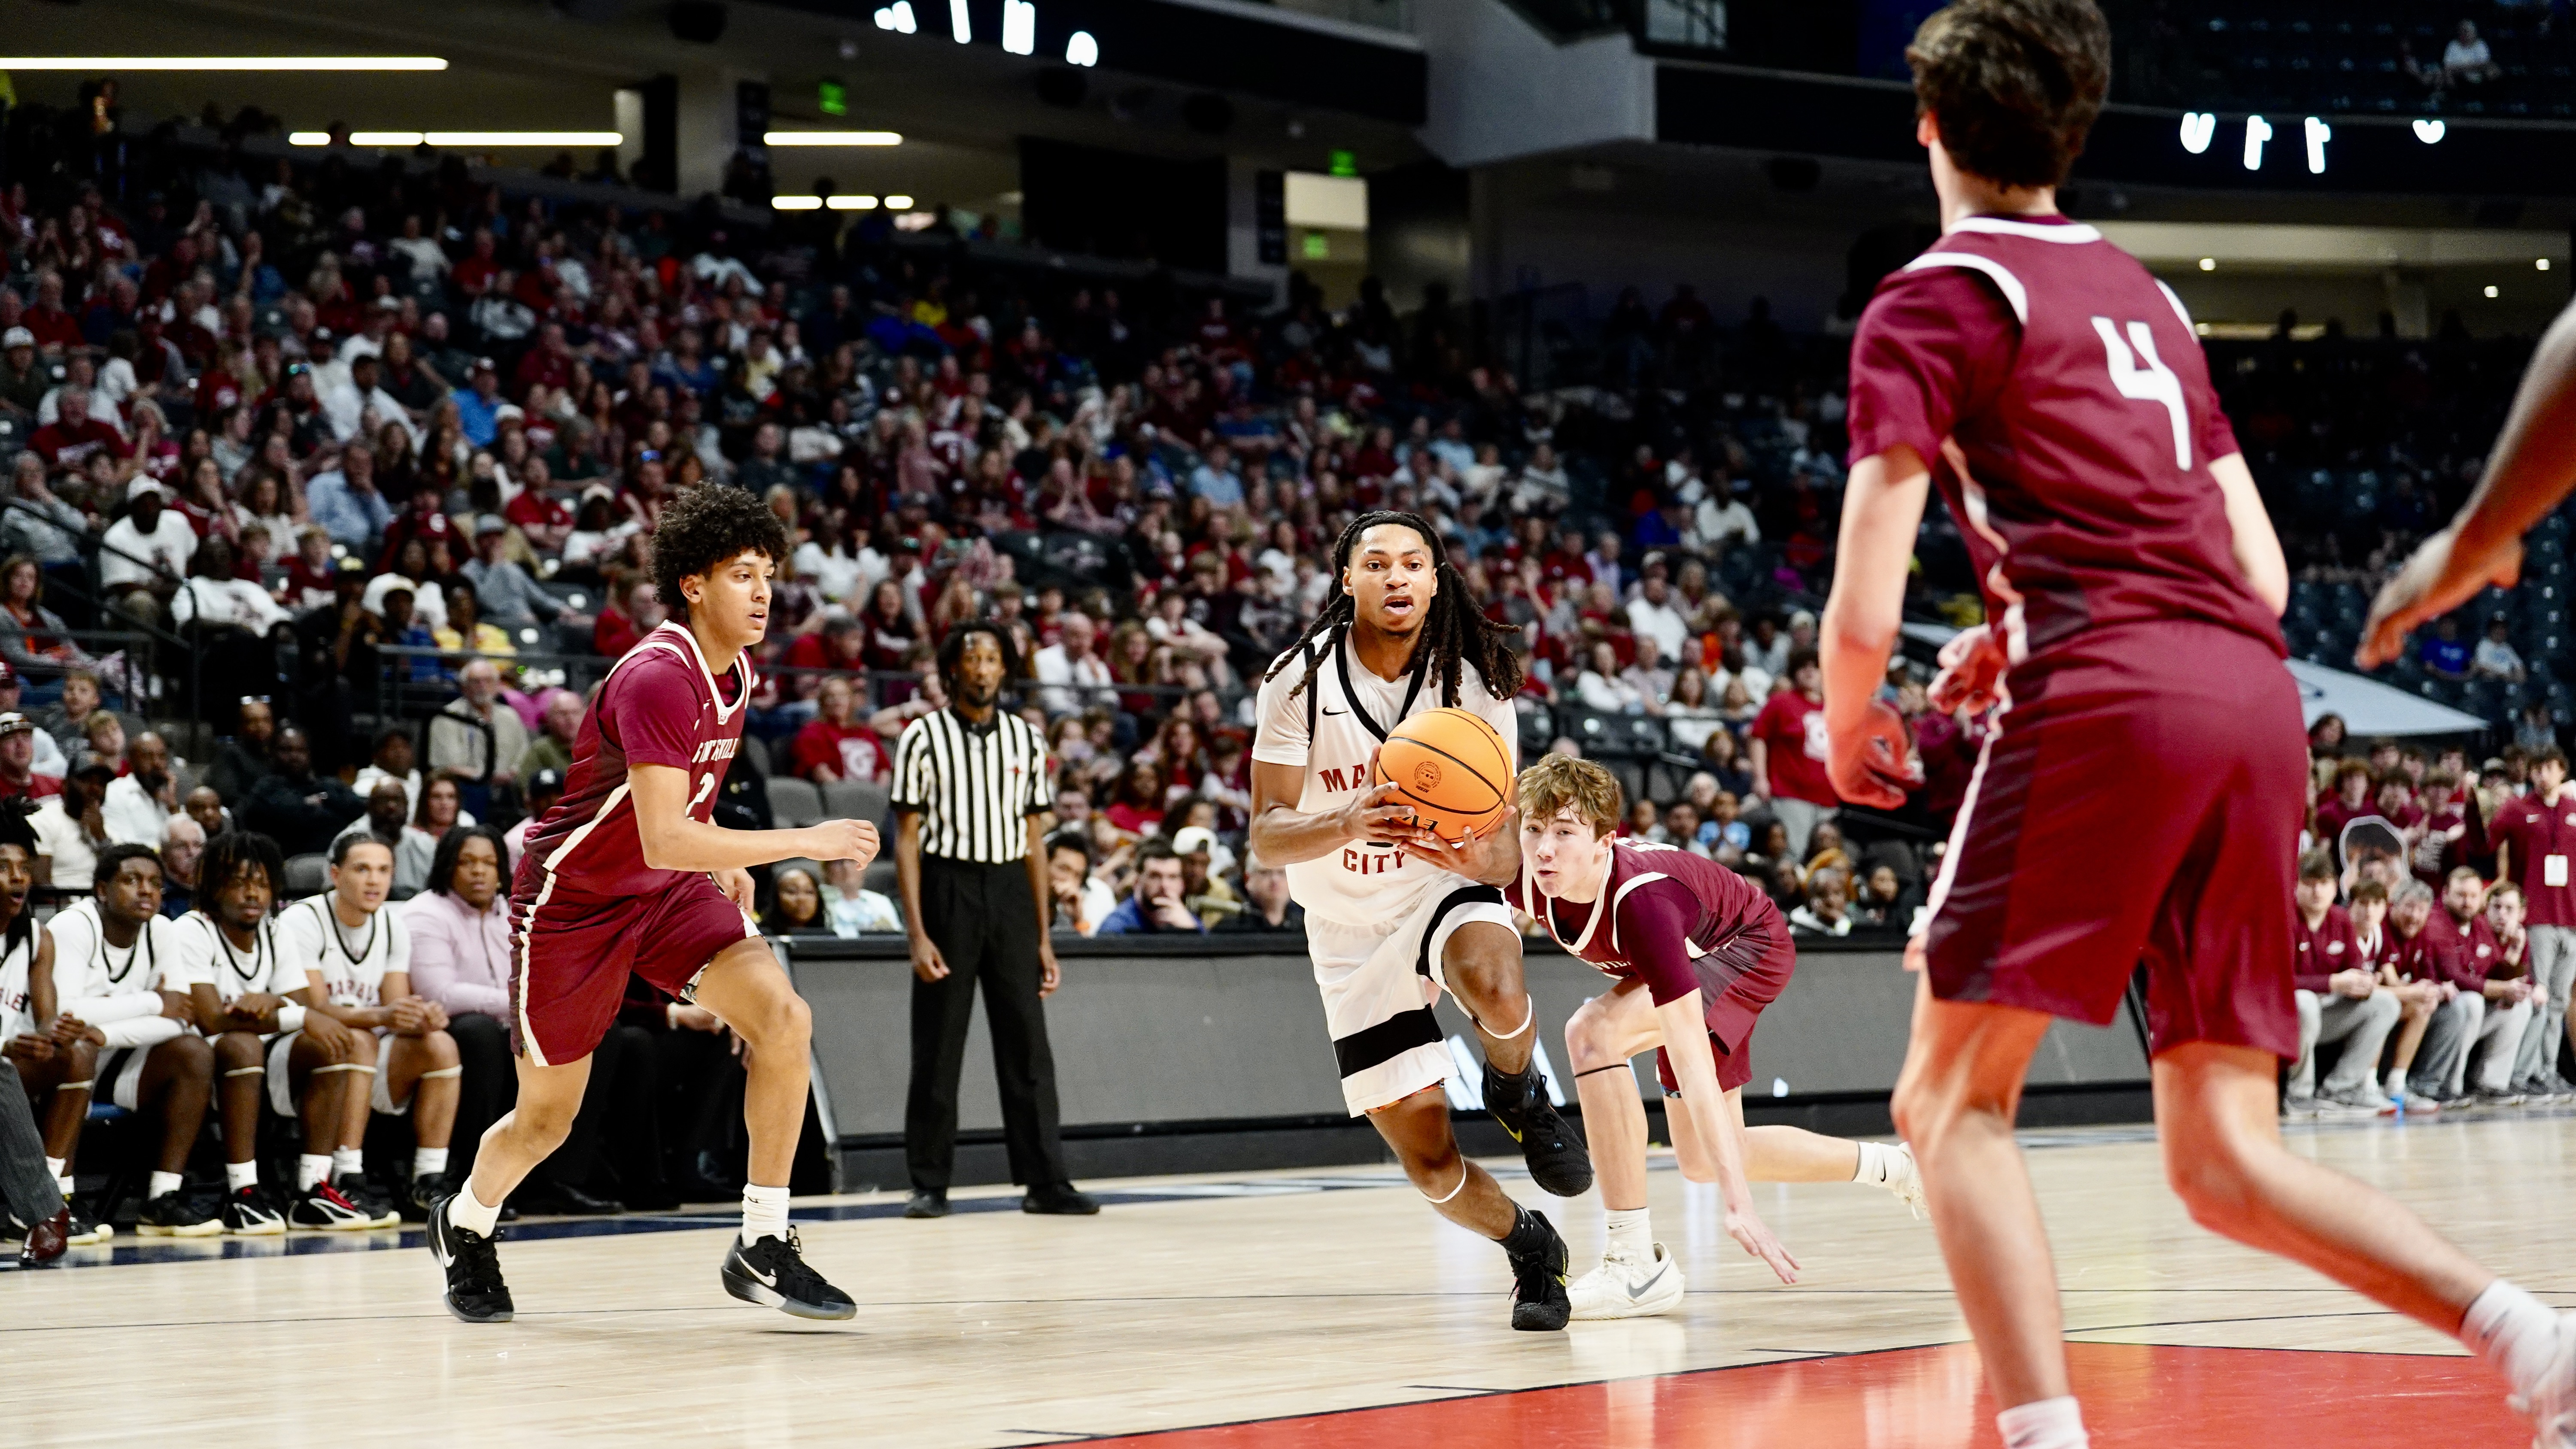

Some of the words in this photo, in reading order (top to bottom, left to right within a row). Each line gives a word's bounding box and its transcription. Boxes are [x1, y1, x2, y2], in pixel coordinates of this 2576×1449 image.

[2091, 315, 2192, 471] 4
[686, 773, 715, 820] 2
[1318, 764, 1366, 792] MA
[1343, 849, 1405, 874] CITY
